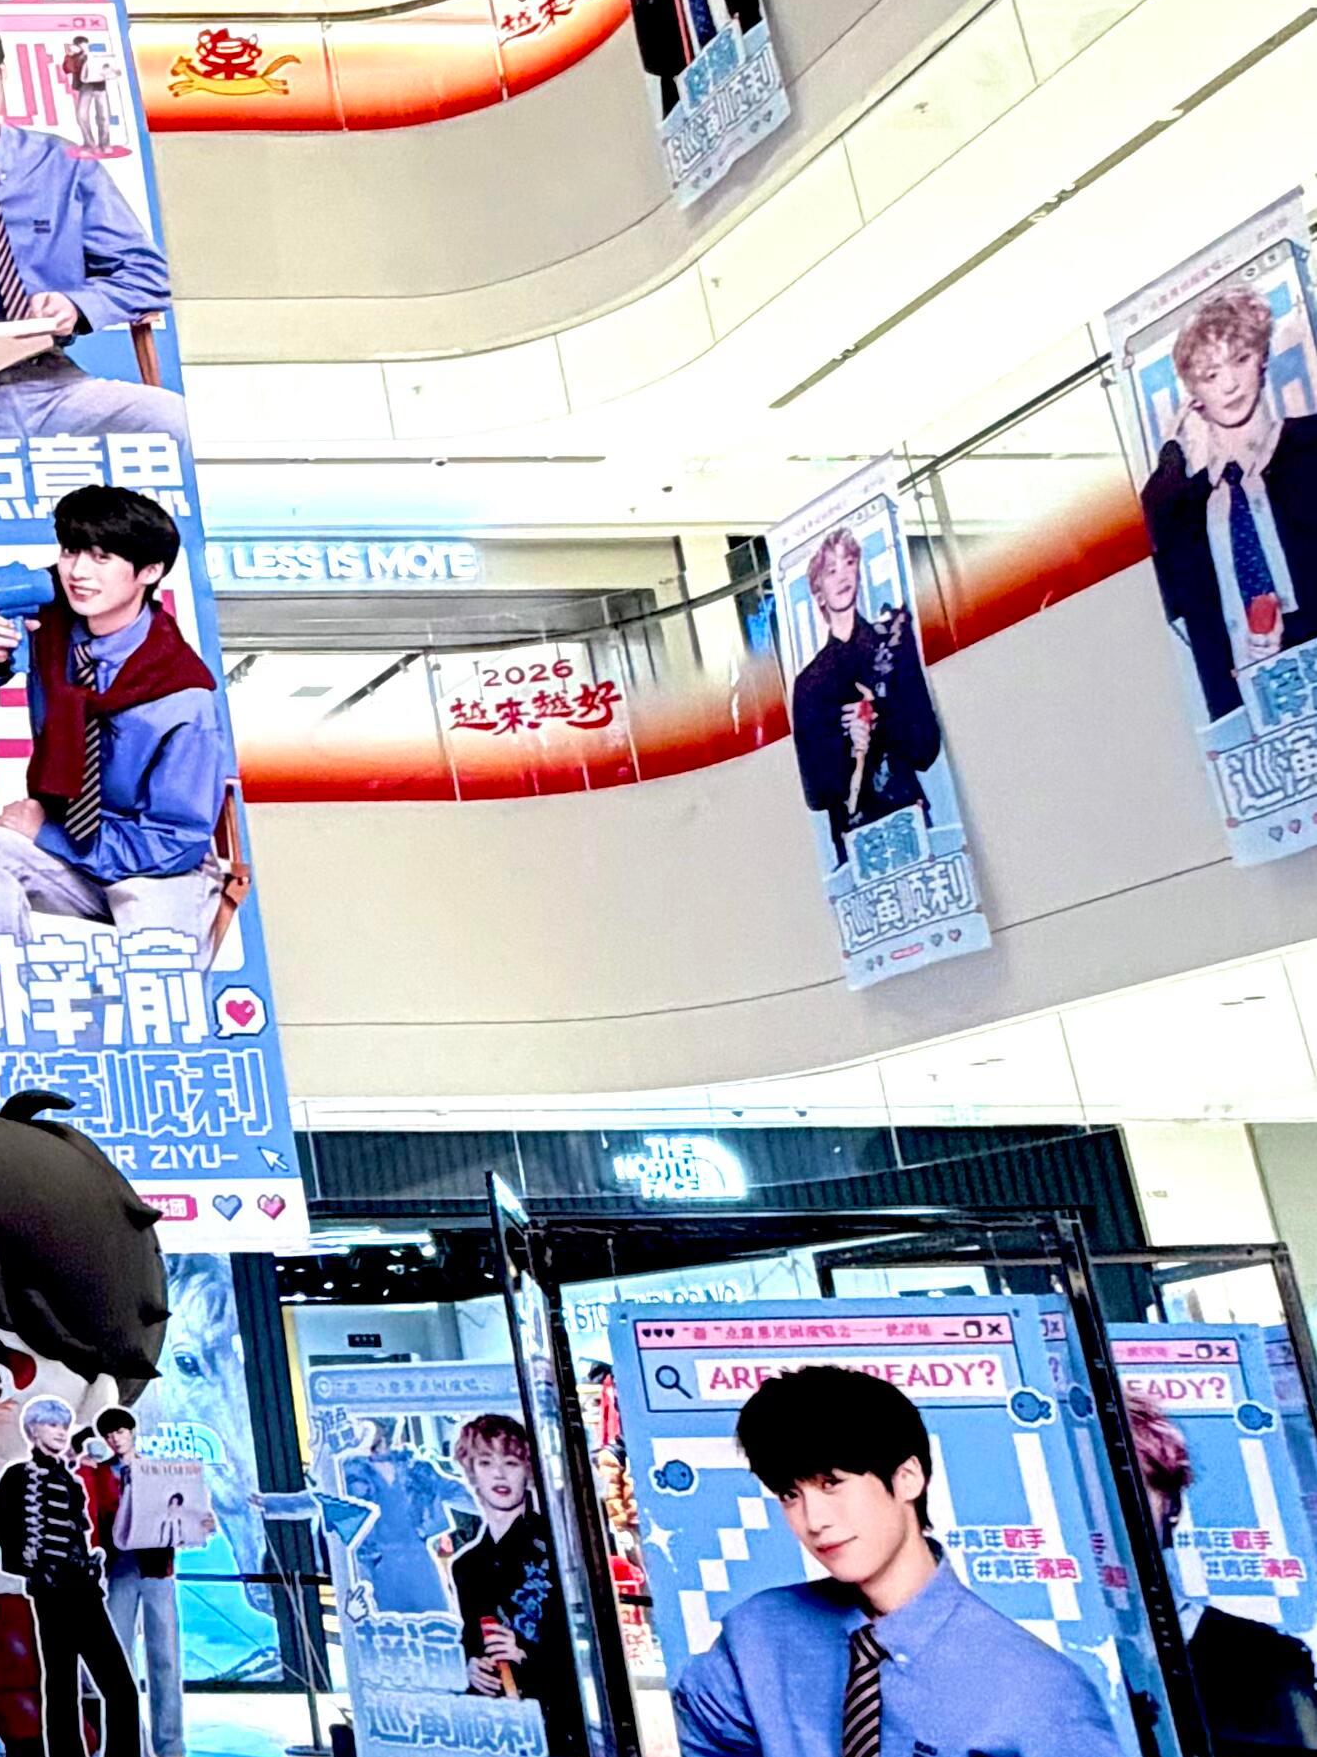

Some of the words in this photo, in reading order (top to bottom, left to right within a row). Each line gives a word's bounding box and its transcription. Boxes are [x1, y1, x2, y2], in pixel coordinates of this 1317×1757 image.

[232, 544, 319, 579] LESS
[326, 544, 362, 579] IS
[482, 659, 574, 688] 2026
[447, 678, 623, 735] 越来越好
[839, 856, 970, 944] 巡演顺利
[644, 1136, 693, 1158] THE
[366, 1703, 547, 1757] 巡演顺利
